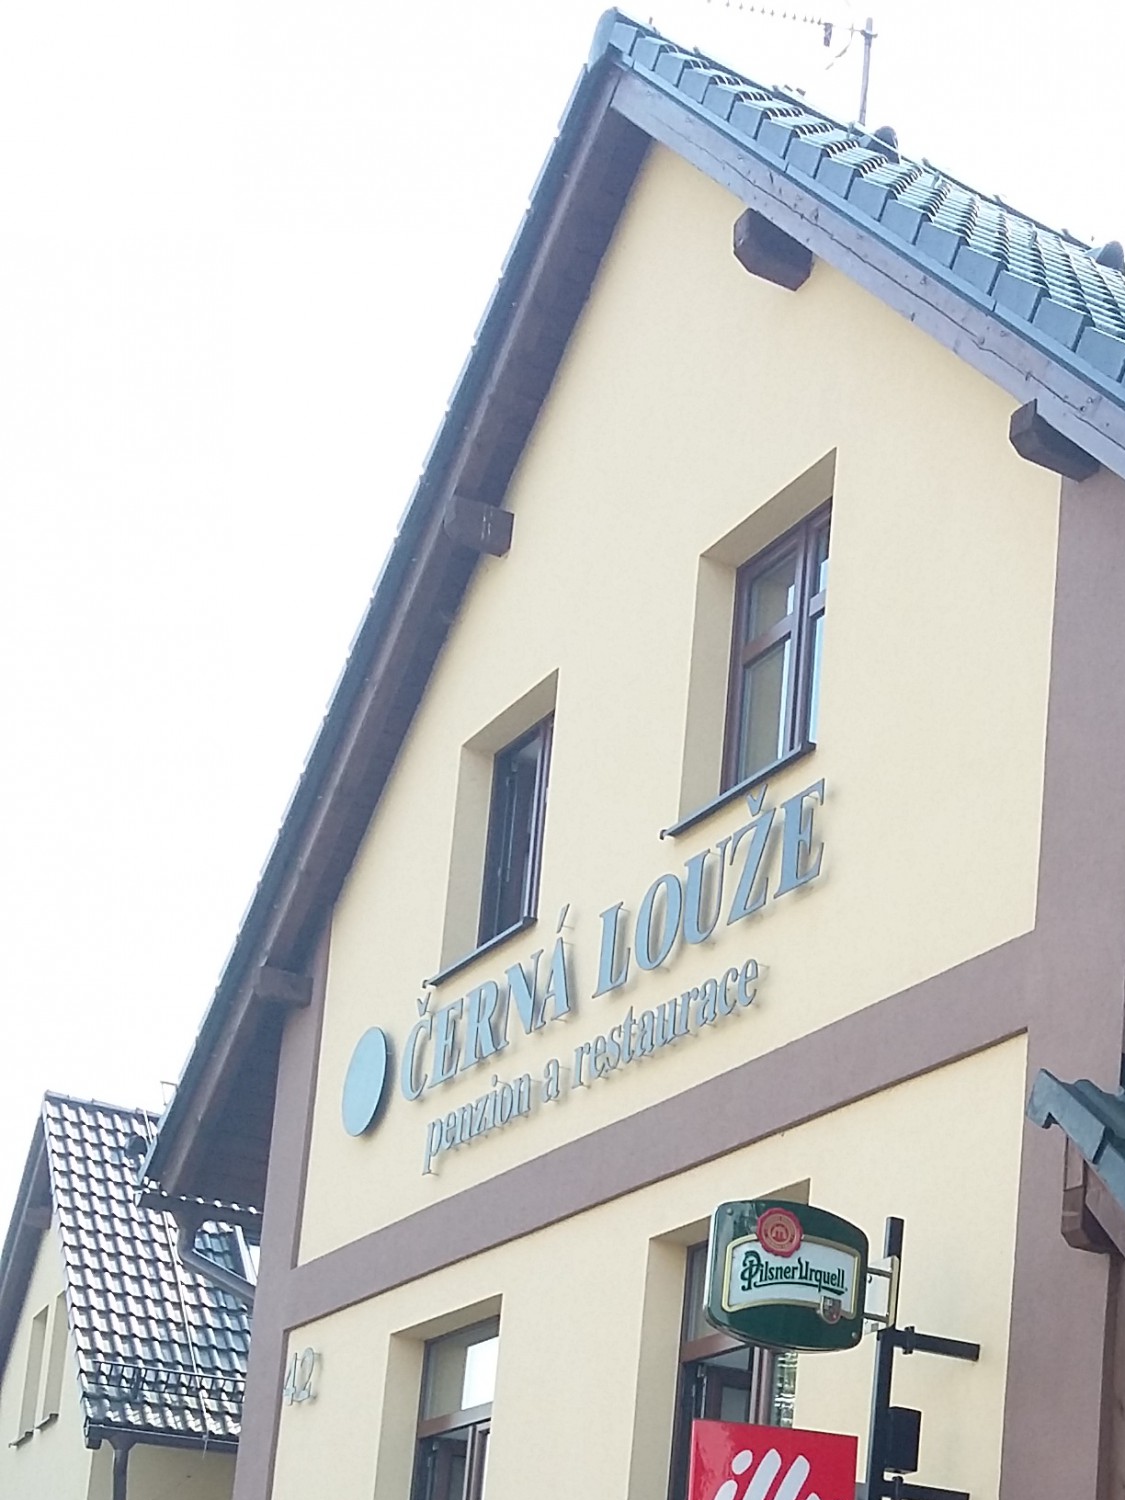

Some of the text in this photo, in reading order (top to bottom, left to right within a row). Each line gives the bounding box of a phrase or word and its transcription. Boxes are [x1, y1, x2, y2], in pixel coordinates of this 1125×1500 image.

[401, 778, 825, 1102] ČERNÁ LOUŽE
[422, 957, 760, 1175] penzion a restaurace
[740, 1250, 845, 1293] Pilsner Urquell
[283, 1347, 315, 1406] 42
